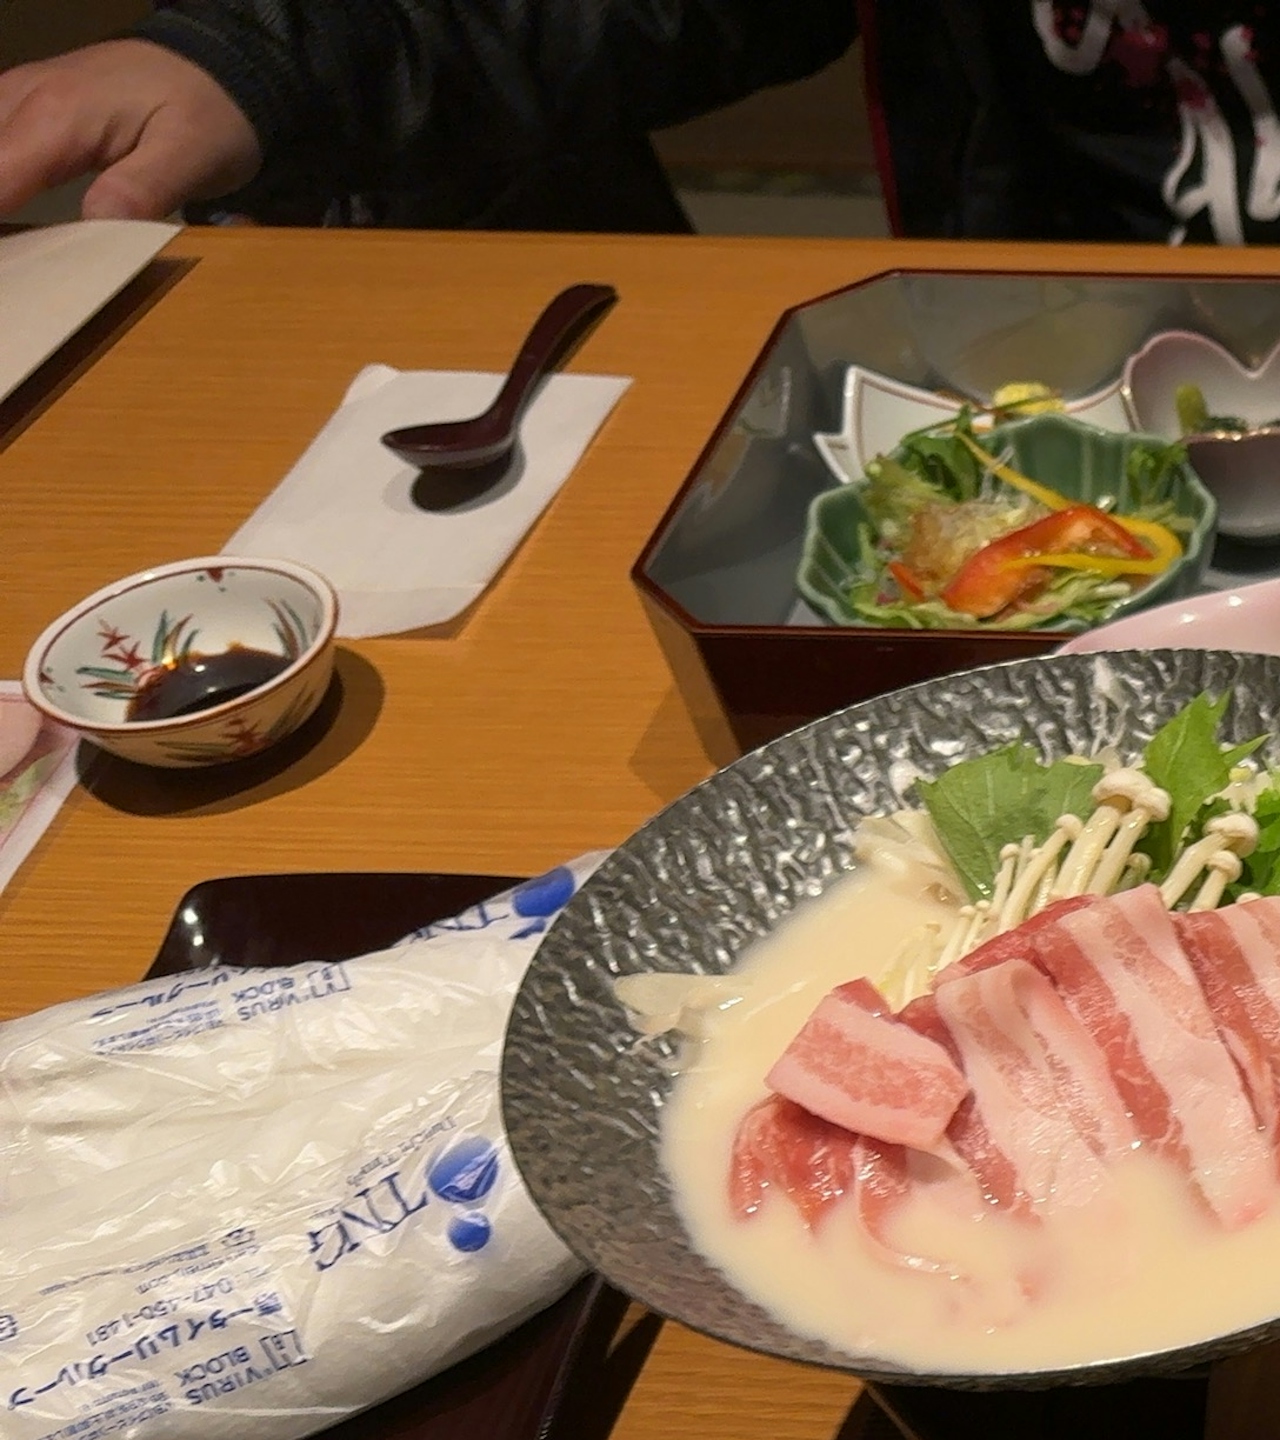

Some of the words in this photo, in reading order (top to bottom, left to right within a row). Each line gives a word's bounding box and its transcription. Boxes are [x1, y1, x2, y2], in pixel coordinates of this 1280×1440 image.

[237, 993, 299, 1022] VIRUS
[302, 1173, 430, 1272] TNG
[174, 1345, 252, 1387] BLOCK
[184, 1364, 263, 1406] VIRUS
